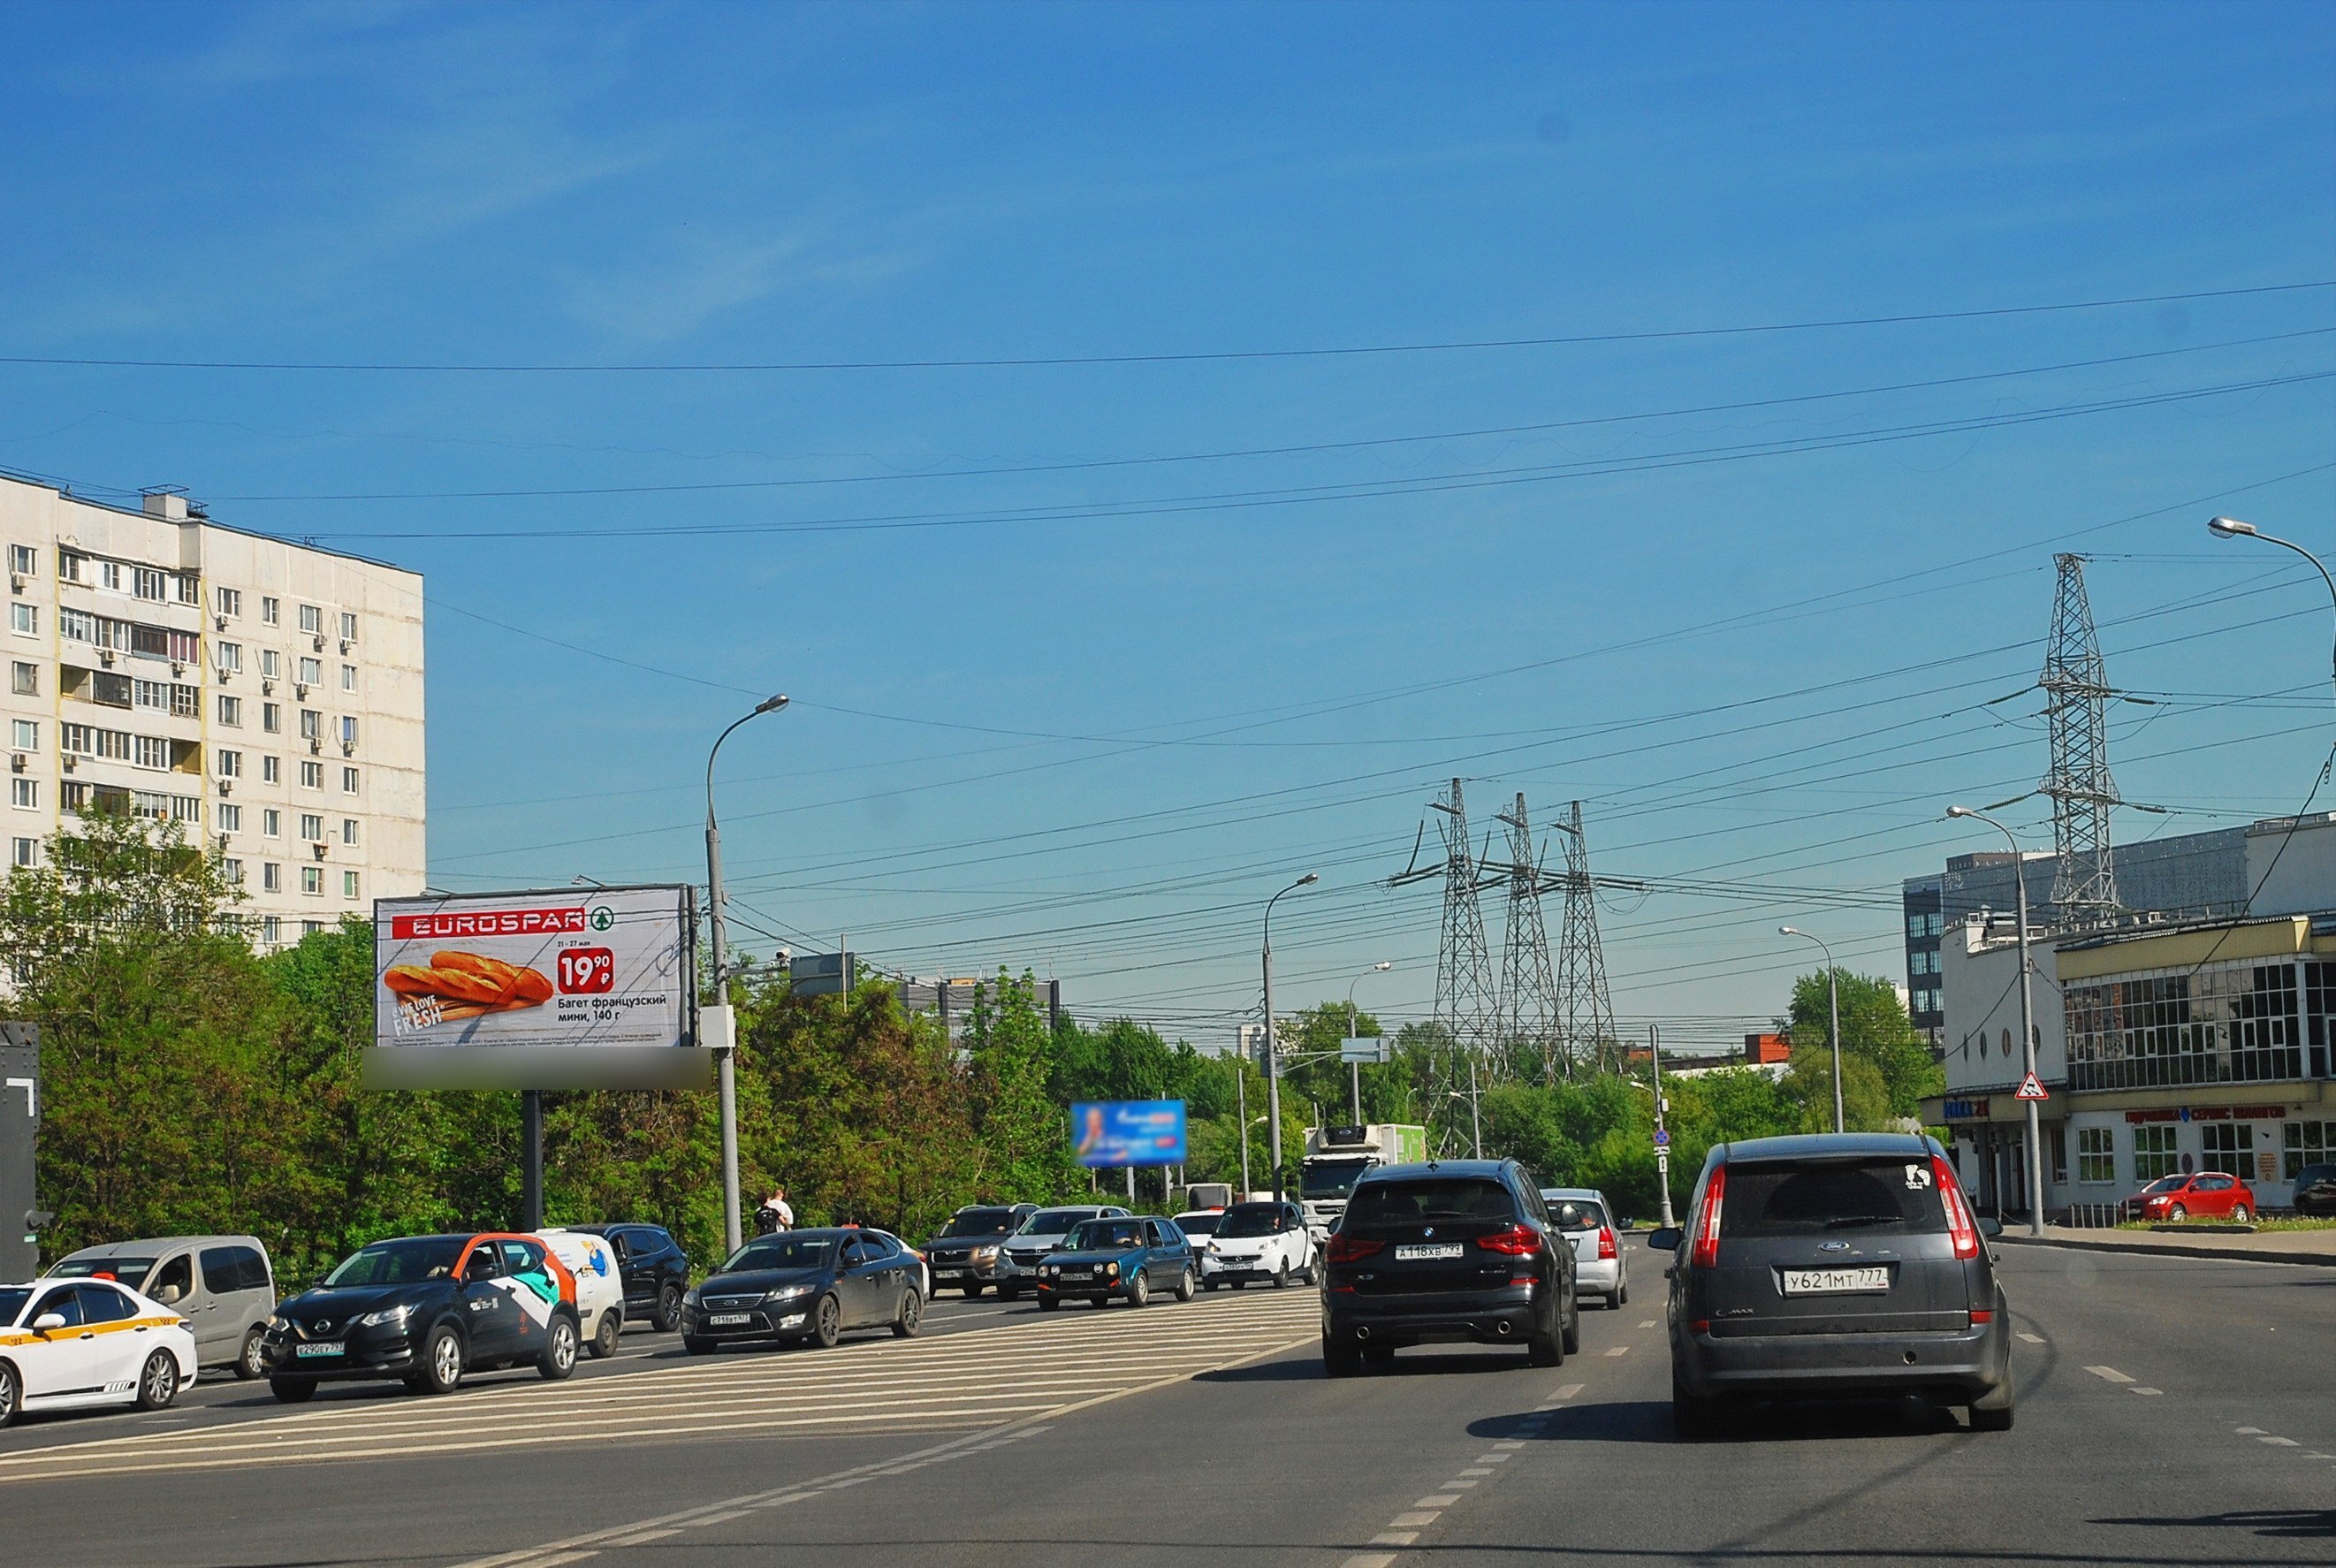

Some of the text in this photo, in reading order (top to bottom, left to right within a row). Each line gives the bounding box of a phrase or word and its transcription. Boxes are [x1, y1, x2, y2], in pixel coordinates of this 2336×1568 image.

[413, 911, 583, 935] EUROSPAR
[561, 955, 610, 986] 19 90
[414, 994, 438, 1011] LOVE
[558, 994, 666, 1010] Багет французский
[558, 1009, 620, 1023] мини, 140 г
[1791, 1269, 1882, 1290] У621МТ 777
